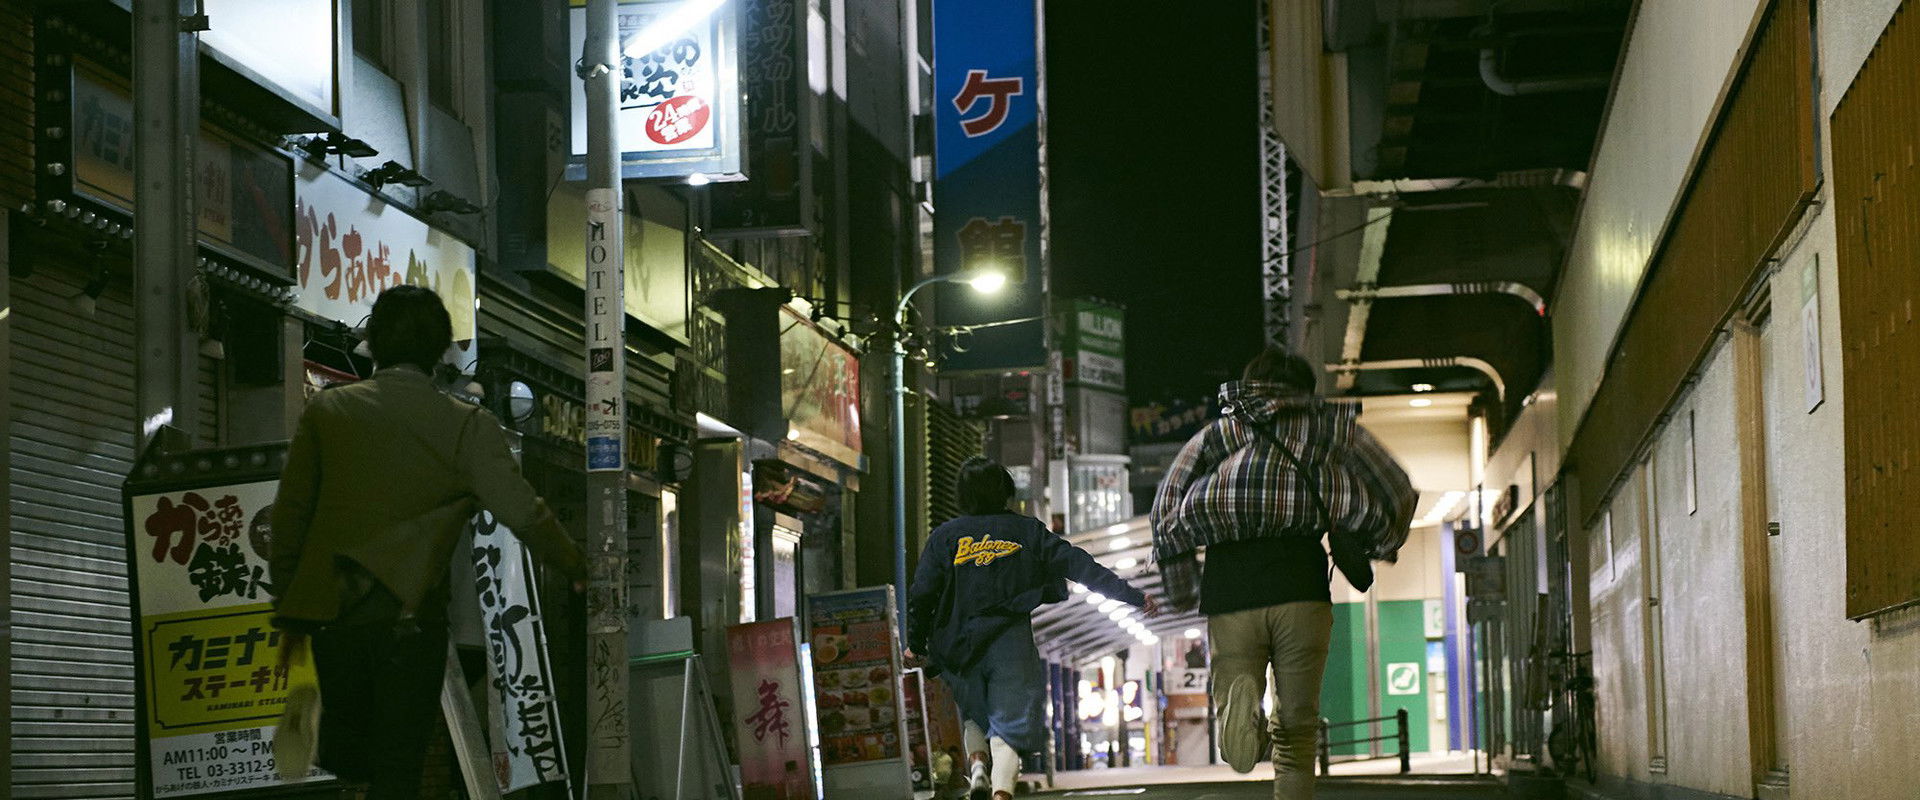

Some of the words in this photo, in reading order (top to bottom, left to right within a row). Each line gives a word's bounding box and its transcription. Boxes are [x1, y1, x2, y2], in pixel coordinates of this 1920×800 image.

[145, 492, 243, 565] からあげの
[188, 543, 276, 603] 鉄人
[169, 627, 281, 672] カミナ
[181, 666, 272, 701] ステーキ
[163, 746, 228, 766] AM11:00
[252, 740, 273, 757] PM
[214, 728, 262, 745] 営業時間
[177, 767, 202, 781] TEL
[207, 758, 276, 778] 03-3312-9
